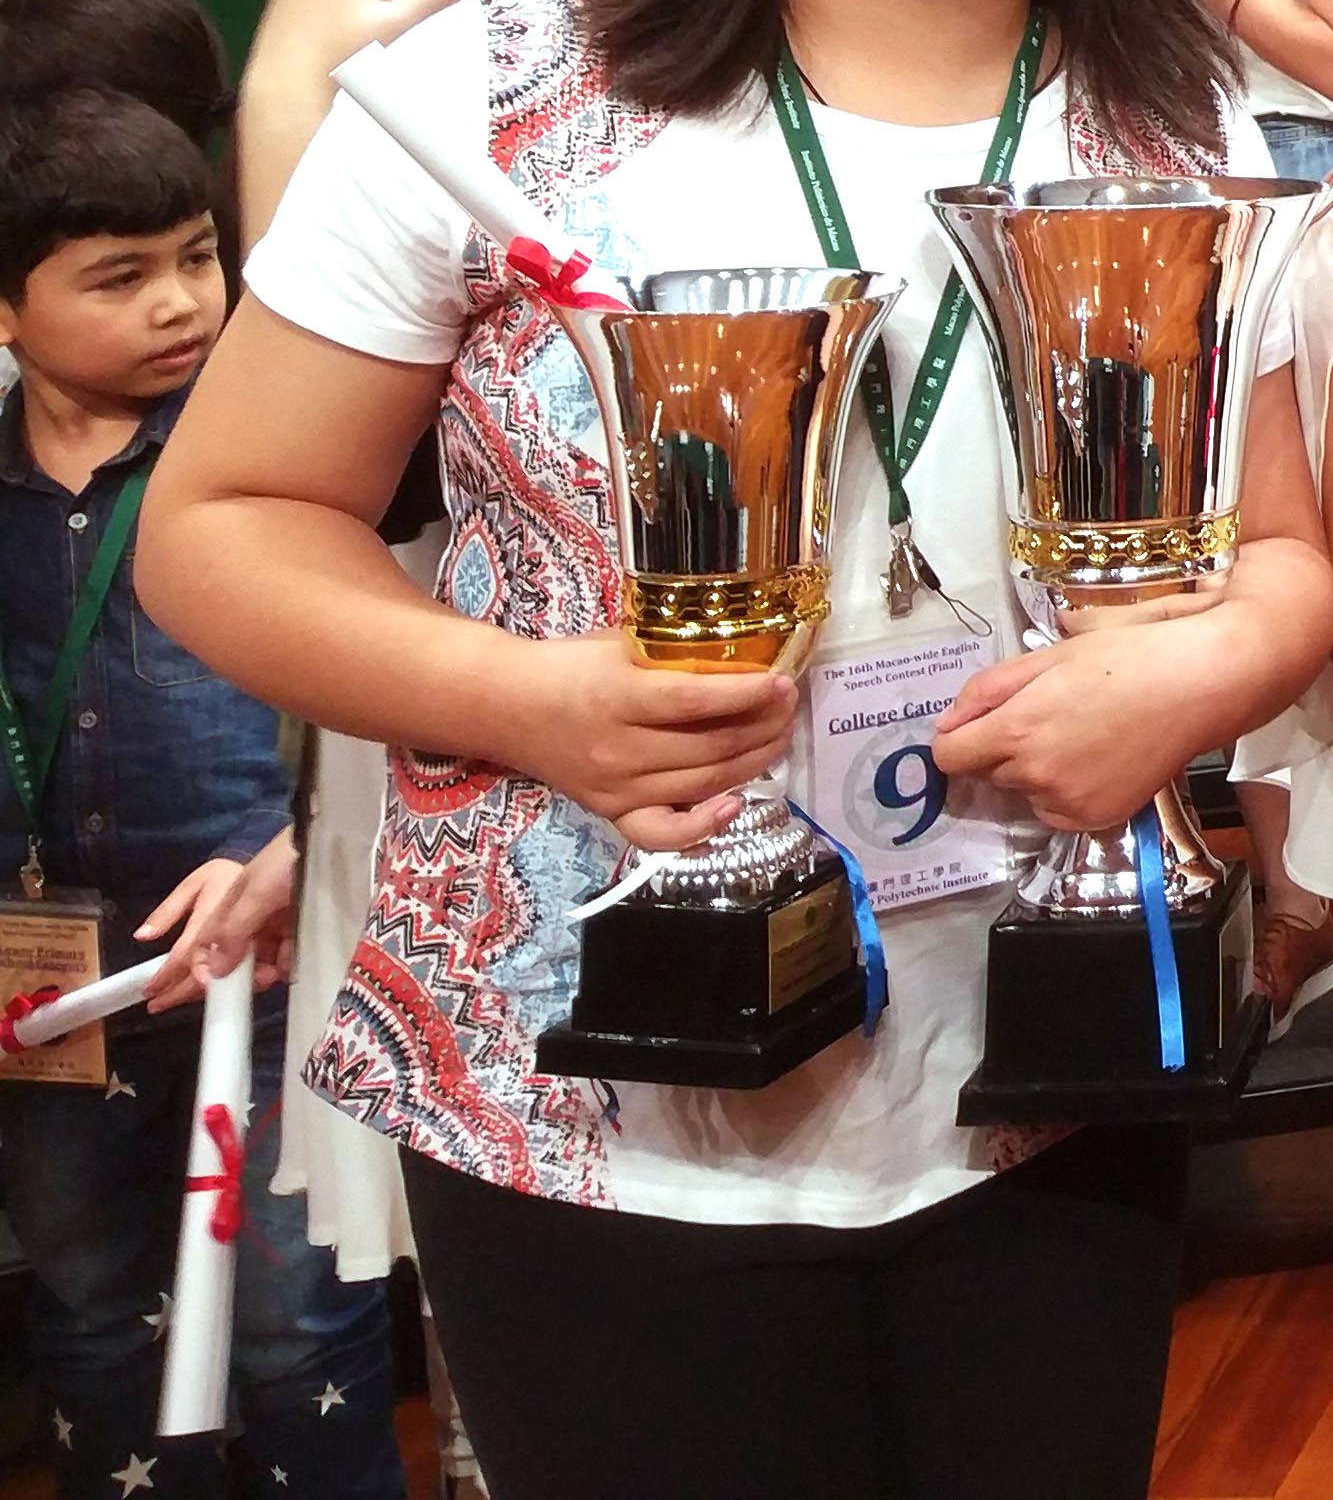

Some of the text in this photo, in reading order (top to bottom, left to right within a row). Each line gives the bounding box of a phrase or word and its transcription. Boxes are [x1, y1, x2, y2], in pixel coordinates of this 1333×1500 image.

[941, 641, 981, 657] English
[843, 658, 964, 692] Speech Contest (Final)
[828, 696, 958, 736] College Categ
[873, 744, 948, 847] 9
